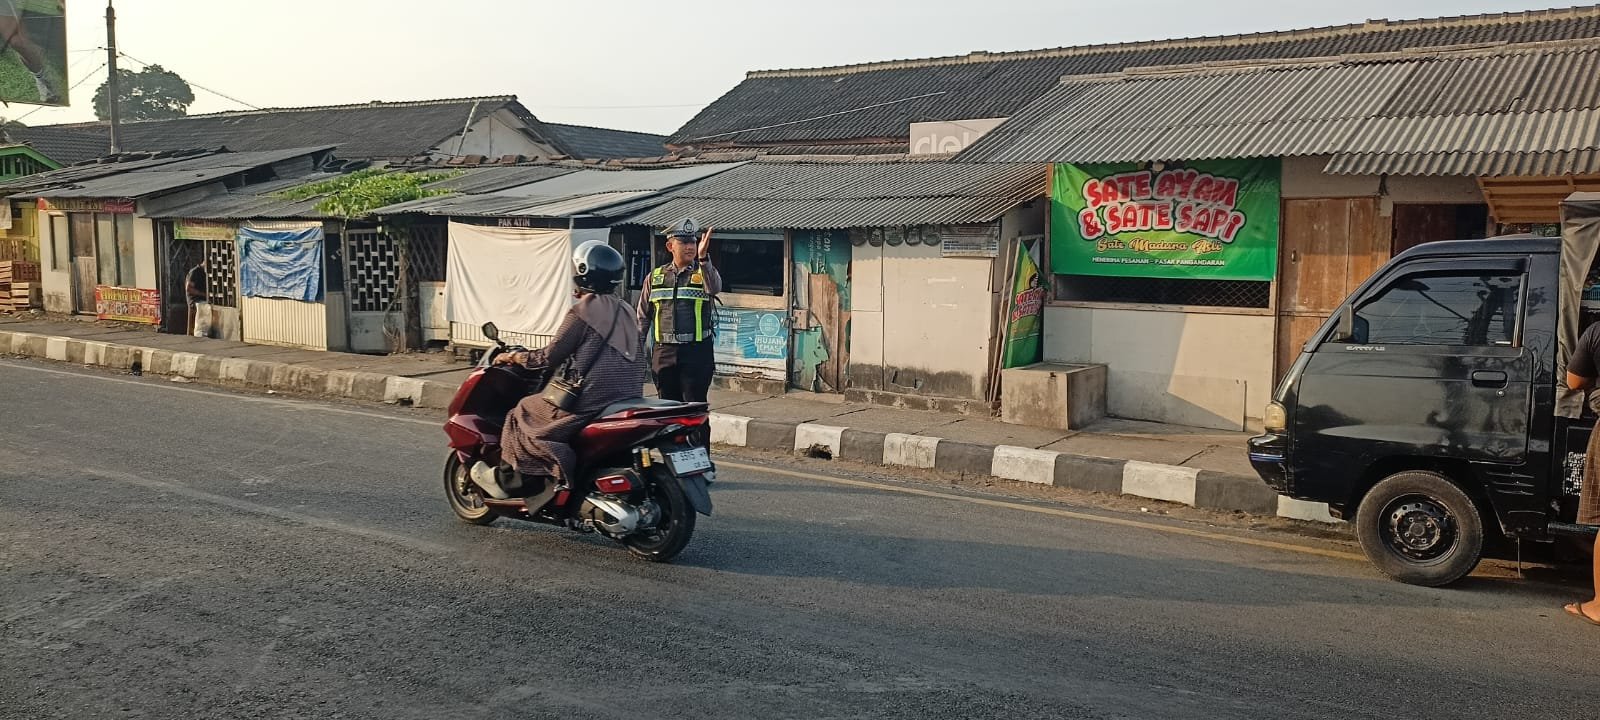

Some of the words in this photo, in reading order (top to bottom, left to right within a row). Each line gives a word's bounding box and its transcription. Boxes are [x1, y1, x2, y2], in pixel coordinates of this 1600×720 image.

[1084, 172, 1151, 208] SATE
[1154, 170, 1239, 208] AYAM
[498, 218, 512, 227] PAK
[1079, 209, 1105, 239] &
[1104, 202, 1173, 233] SATE
[1097, 237, 1125, 253] Sate
[1128, 238, 1188, 253] Madura
[1190, 238, 1223, 255] Asli
[1092, 256, 1120, 264] MENERIMA
[1121, 257, 1149, 265] PESANAN
